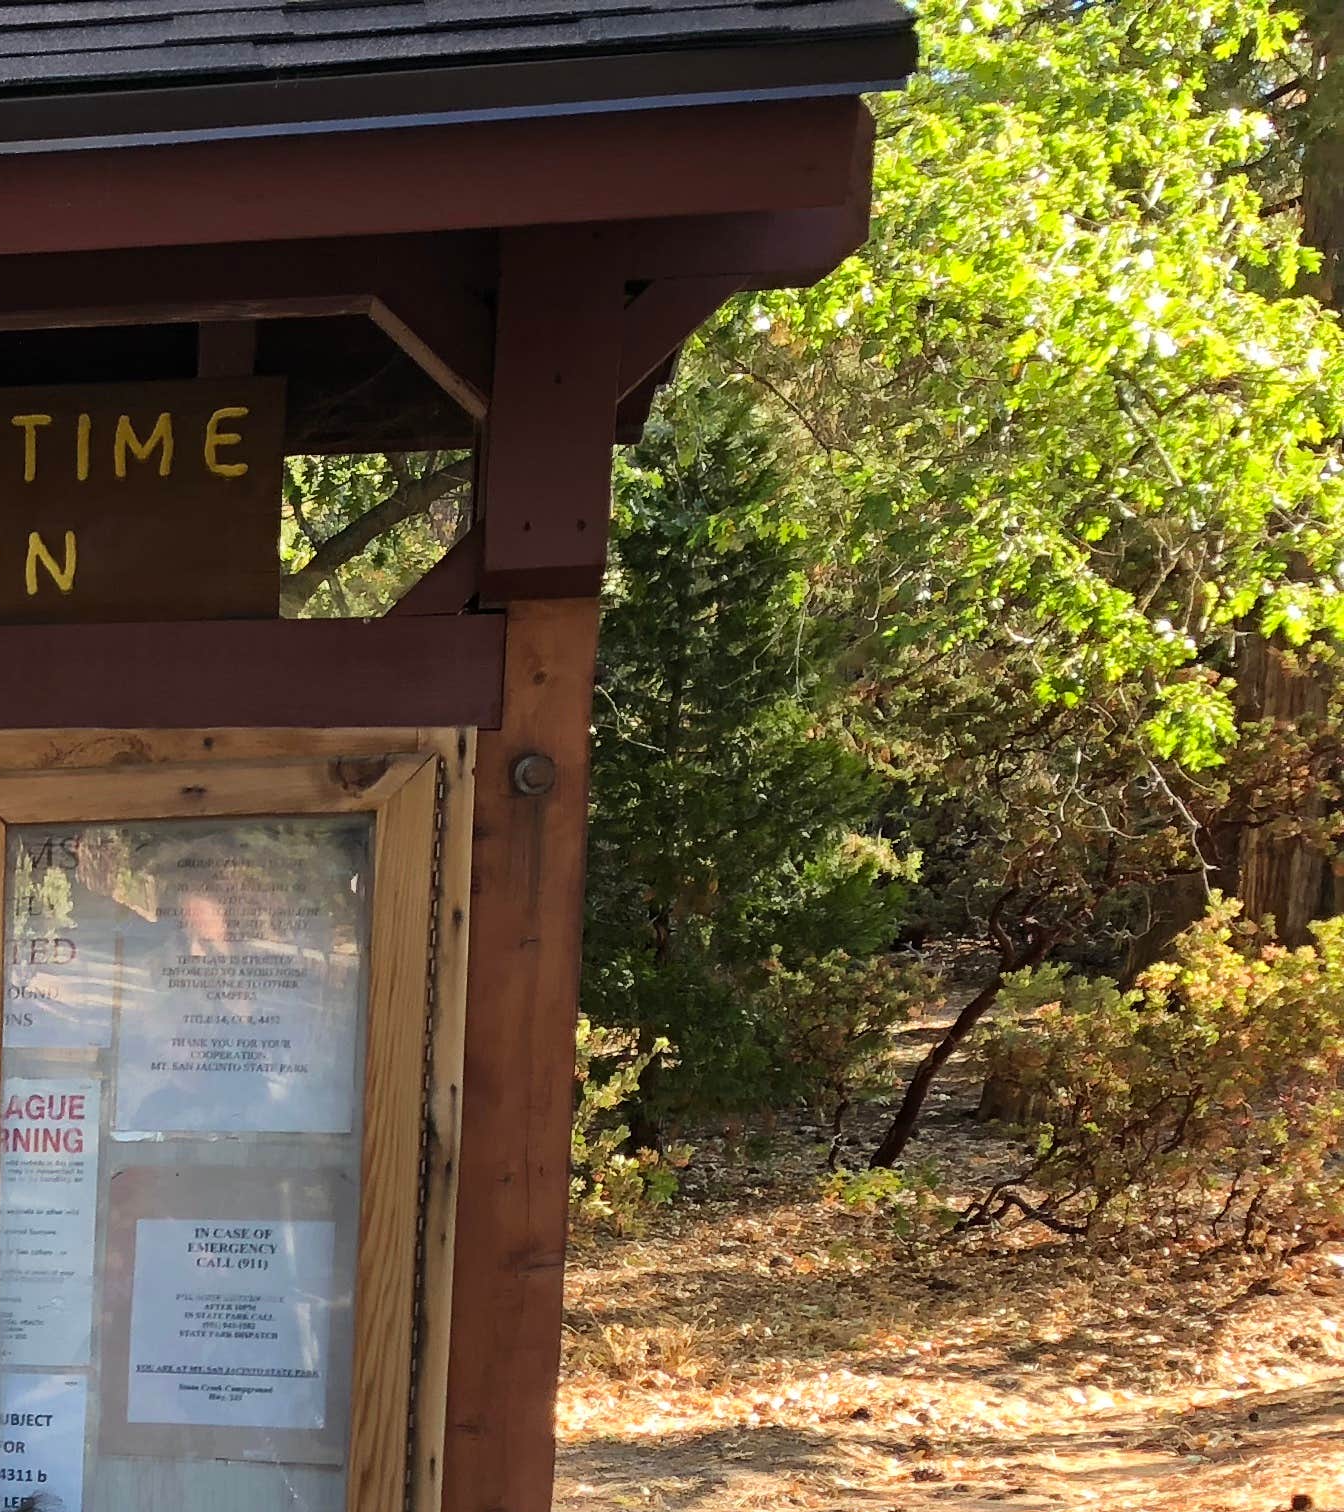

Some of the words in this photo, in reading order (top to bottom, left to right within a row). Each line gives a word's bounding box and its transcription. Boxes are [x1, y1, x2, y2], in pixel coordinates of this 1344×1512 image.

[12, 406, 250, 483] TIME
[194, 1228, 210, 1239] IN
[213, 1228, 249, 1239] CASE
[254, 1229, 273, 1239] OF
[187, 1242, 278, 1255] EMERGENCY
[196, 1257, 234, 1268] CALL
[238, 1258, 269, 1270] (911)
[37, 1469, 47, 1483] b
